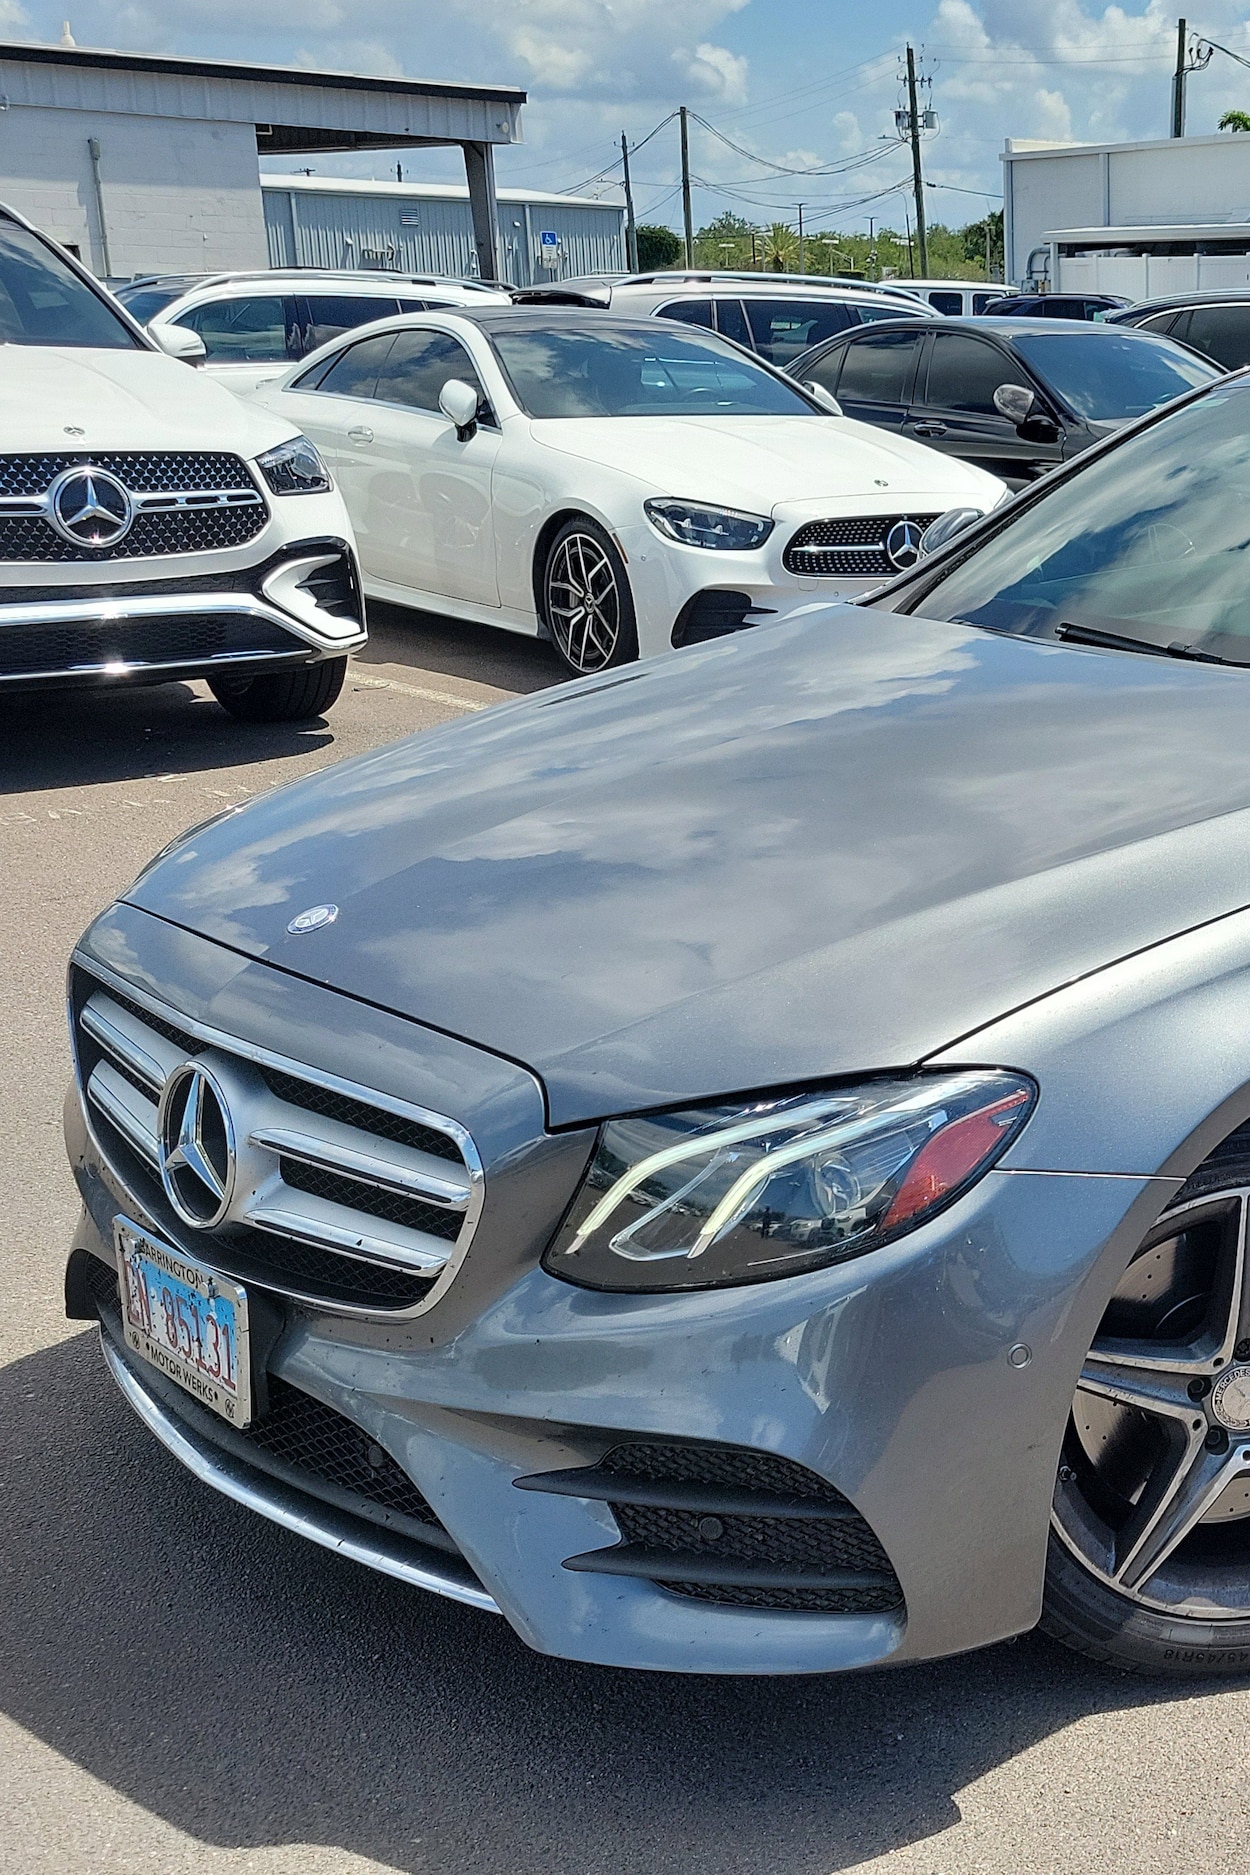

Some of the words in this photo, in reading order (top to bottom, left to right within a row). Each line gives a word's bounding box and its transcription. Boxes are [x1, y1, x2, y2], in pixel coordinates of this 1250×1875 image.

[151, 1346, 182, 1379] MOTOR
[183, 1368, 214, 1403] WERKS
[162, 1287, 236, 1391] 85131
